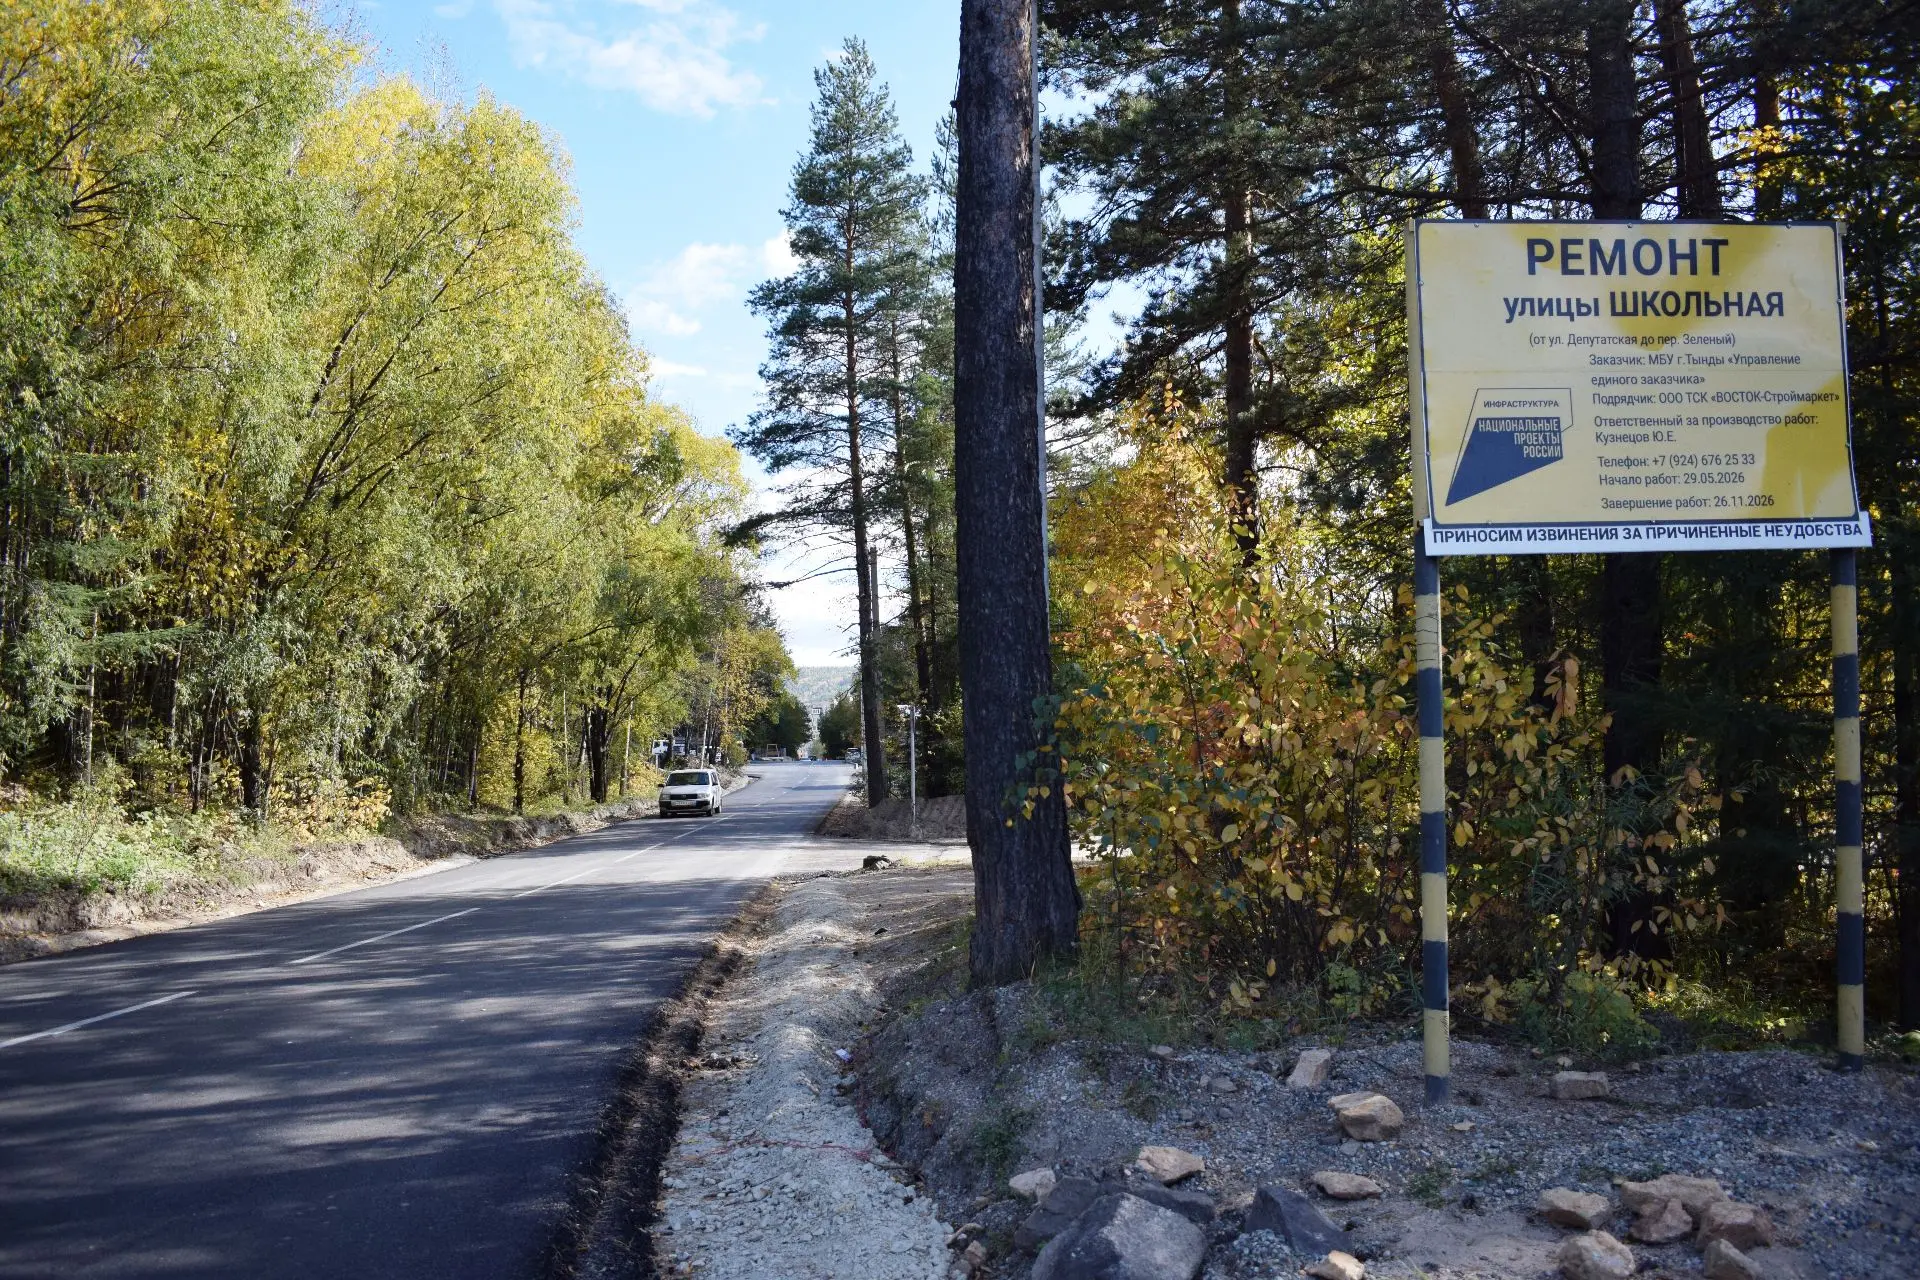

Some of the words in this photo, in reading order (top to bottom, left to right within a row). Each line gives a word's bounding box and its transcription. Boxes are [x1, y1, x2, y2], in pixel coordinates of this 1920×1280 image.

[1526, 238, 1729, 276] РЕМОНТ
[1503, 296, 1599, 324] улицы
[1609, 291, 1785, 319] ШКОЛЬНАЯ
[1529, 332, 1545, 347] (от
[1549, 335, 1564, 347] ул.
[1567, 333, 1637, 348] Депутатская
[1640, 335, 1655, 346] до
[1657, 335, 1680, 347] пер.
[1682, 332, 1736, 346] Зеленый)
[1589, 353, 1646, 366] Заказчик:
[1648, 353, 1674, 365] МБУ
[1727, 353, 1801, 366] «Управление
[1591, 375, 1638, 387] единого
[1640, 374, 1706, 385] заказчика»
[1483, 400, 1559, 408] ИНФРАСТРУКТУРА
[1592, 393, 1656, 407] Подрядчик:
[1658, 392, 1683, 404] ООО
[1685, 391, 1708, 403] ТСК
[1710, 391, 1840, 404] «ВОСТОК-Строймаркет»
[1478, 419, 1559, 432] НАЦИОНАЛЬНЫЕ
[1594, 414, 1683, 427] Ответственный
[1686, 417, 1699, 426] за
[1701, 414, 1782, 428] производство
[1784, 412, 1819, 426] работ:
[1514, 432, 1560, 445] ПРОЕКТЫ
[1595, 431, 1650, 446] Кузнецов
[1652, 430, 1677, 442] Ю.Е.
[1523, 445, 1561, 458] РОССИИ
[1598, 456, 1650, 470] Телефон:
[1652, 455, 1666, 467] +7
[1669, 454, 1698, 469] (924)
[1701, 454, 1722, 466] 676
[1725, 454, 1739, 465] 25
[1742, 453, 1755, 465] 33
[1599, 474, 1642, 486] Начало
[1645, 473, 1681, 487] работ:
[1683, 472, 1745, 484] 29.05.2026
[1601, 498, 1673, 511] Завершение
[1676, 496, 1712, 510] работ:
[1714, 494, 1775, 508] 26.11.2026
[1433, 529, 1523, 544] ПРИНОСИМ
[1527, 527, 1618, 541] ИЗВИНЕНИЯ
[1622, 527, 1642, 540] ЗА
[1646, 525, 1761, 540] ПРИЧИНЕННЫЕ
[1765, 523, 1863, 540] НЕУДОБСТВА
